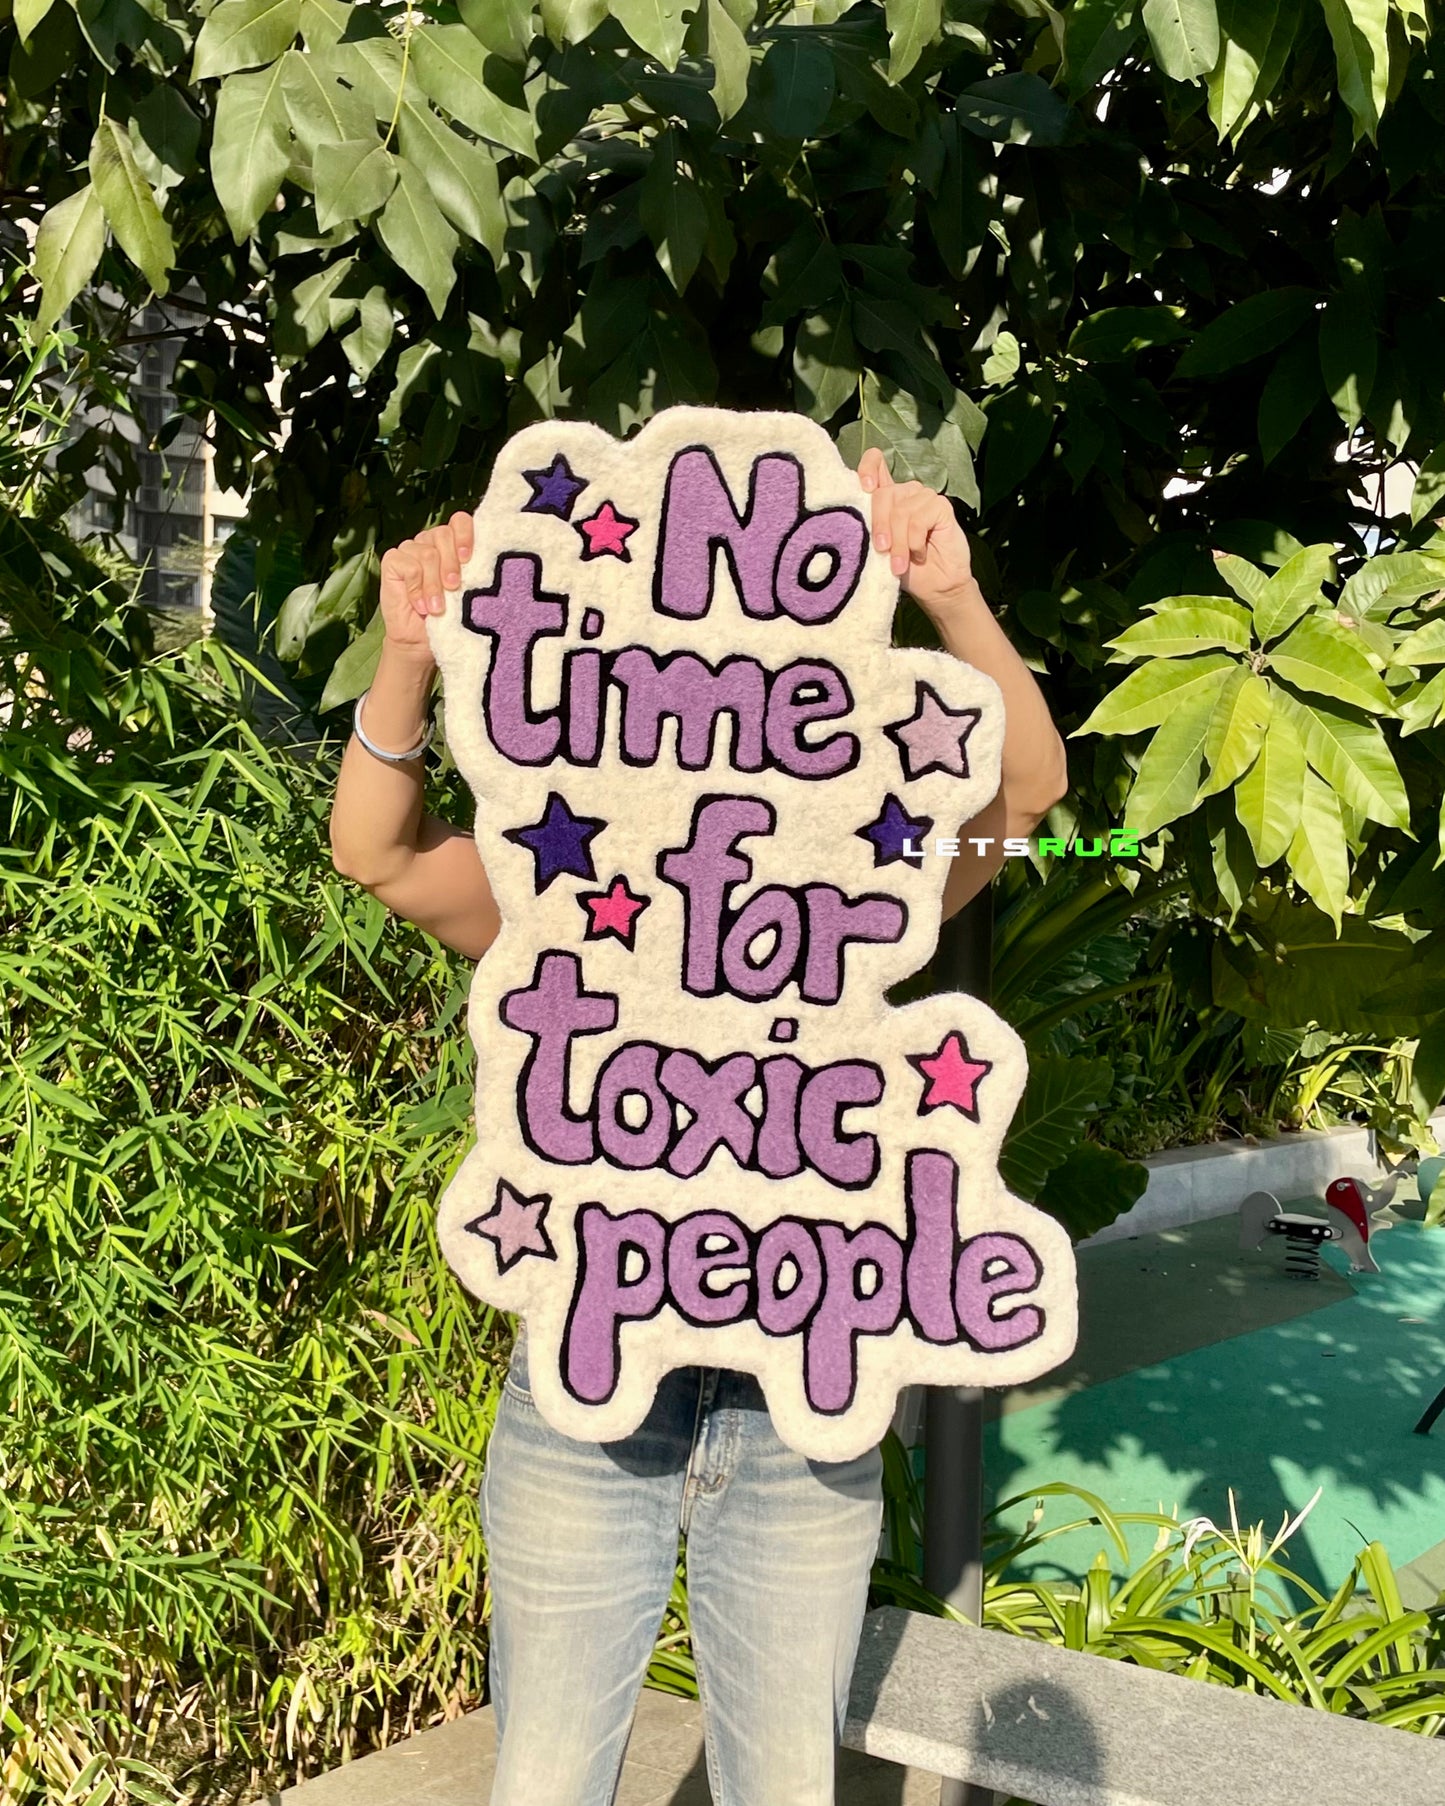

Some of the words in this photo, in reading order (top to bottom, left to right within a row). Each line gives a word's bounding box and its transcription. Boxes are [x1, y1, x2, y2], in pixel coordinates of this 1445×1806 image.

[653, 445, 871, 624] No
[463, 552, 860, 780] time
[657, 793, 908, 1004] for
[500, 949, 885, 1190] toxic
[559, 1149, 1045, 1415] people
